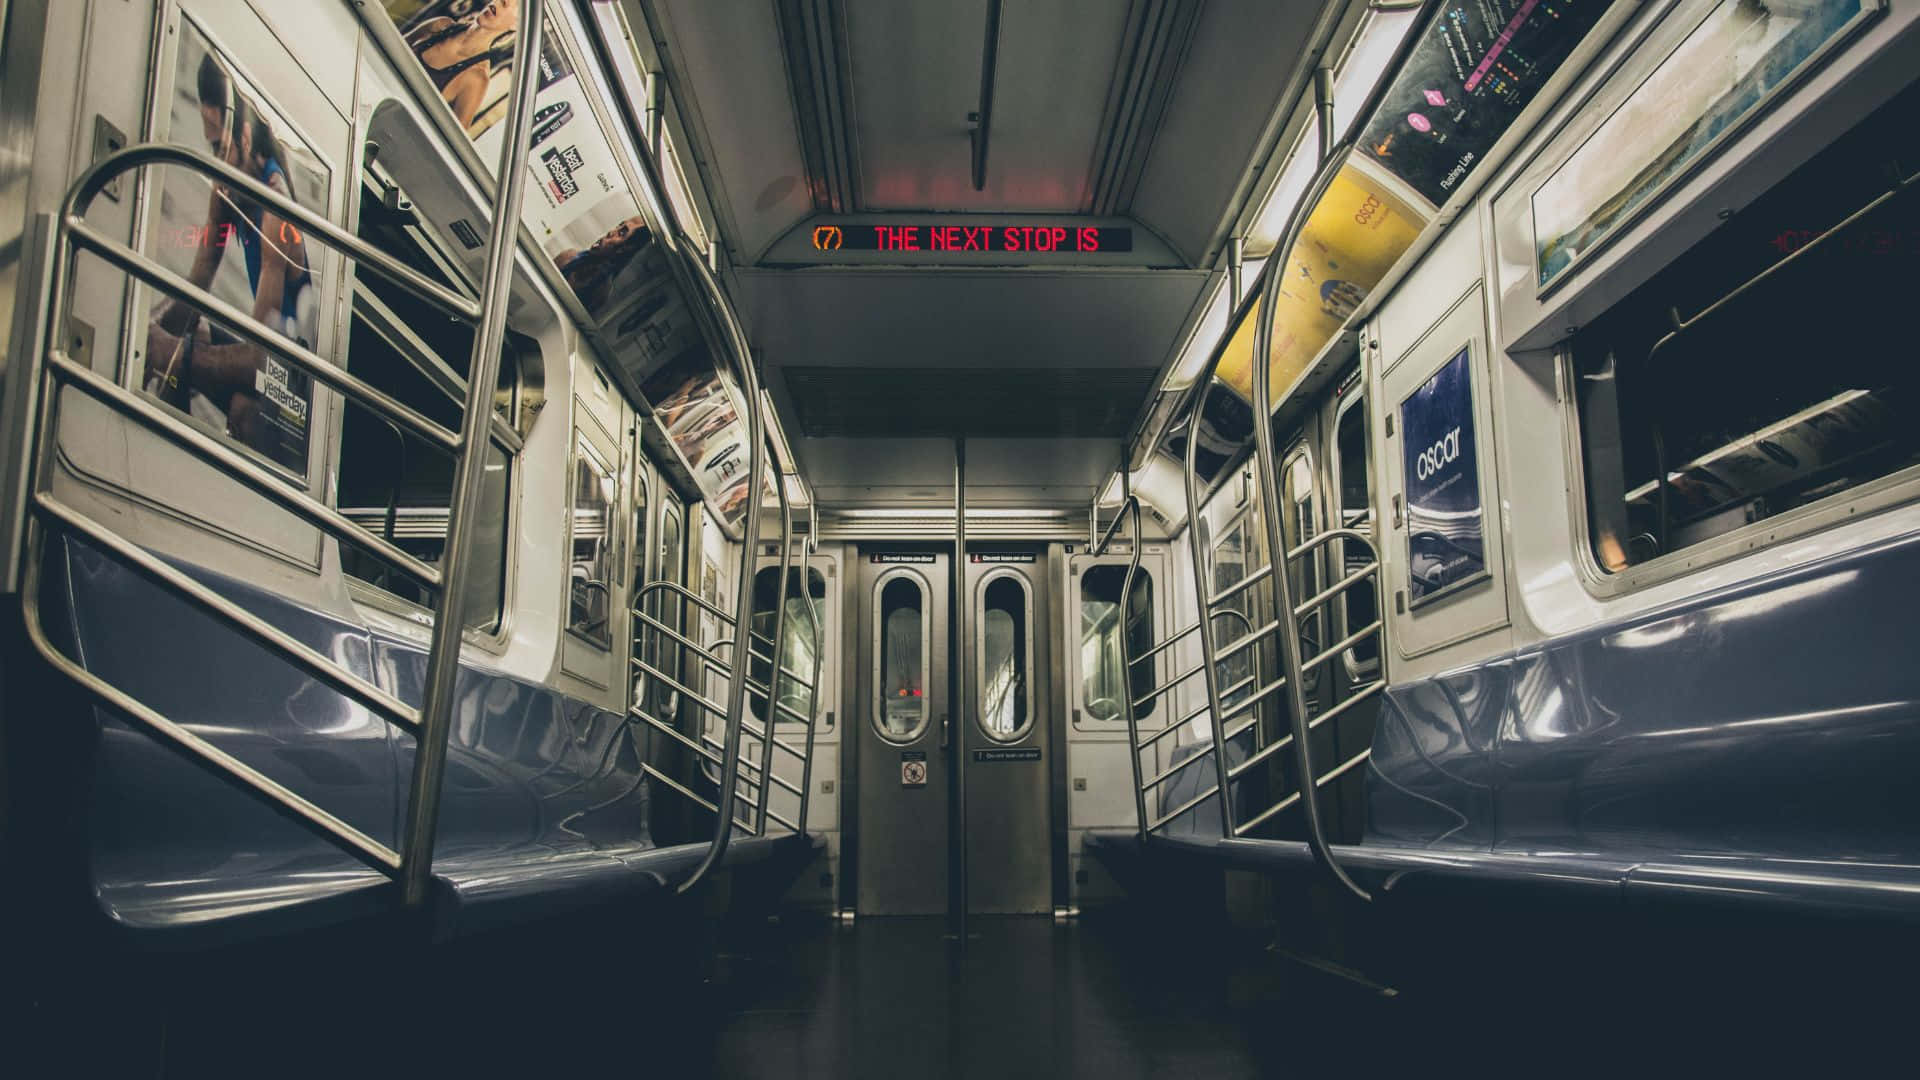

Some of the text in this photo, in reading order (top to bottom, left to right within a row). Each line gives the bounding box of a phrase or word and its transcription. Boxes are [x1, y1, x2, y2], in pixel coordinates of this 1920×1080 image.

[561, 148, 583, 171] beat
[1440, 163, 1465, 190] Flushing
[1458, 151, 1475, 167] Line
[813, 226, 1099, 250] (7) THE NEXT STOP IS
[268, 361, 288, 386] beat
[264, 378, 305, 418] yesterday.
[1417, 426, 1460, 481] oscar
